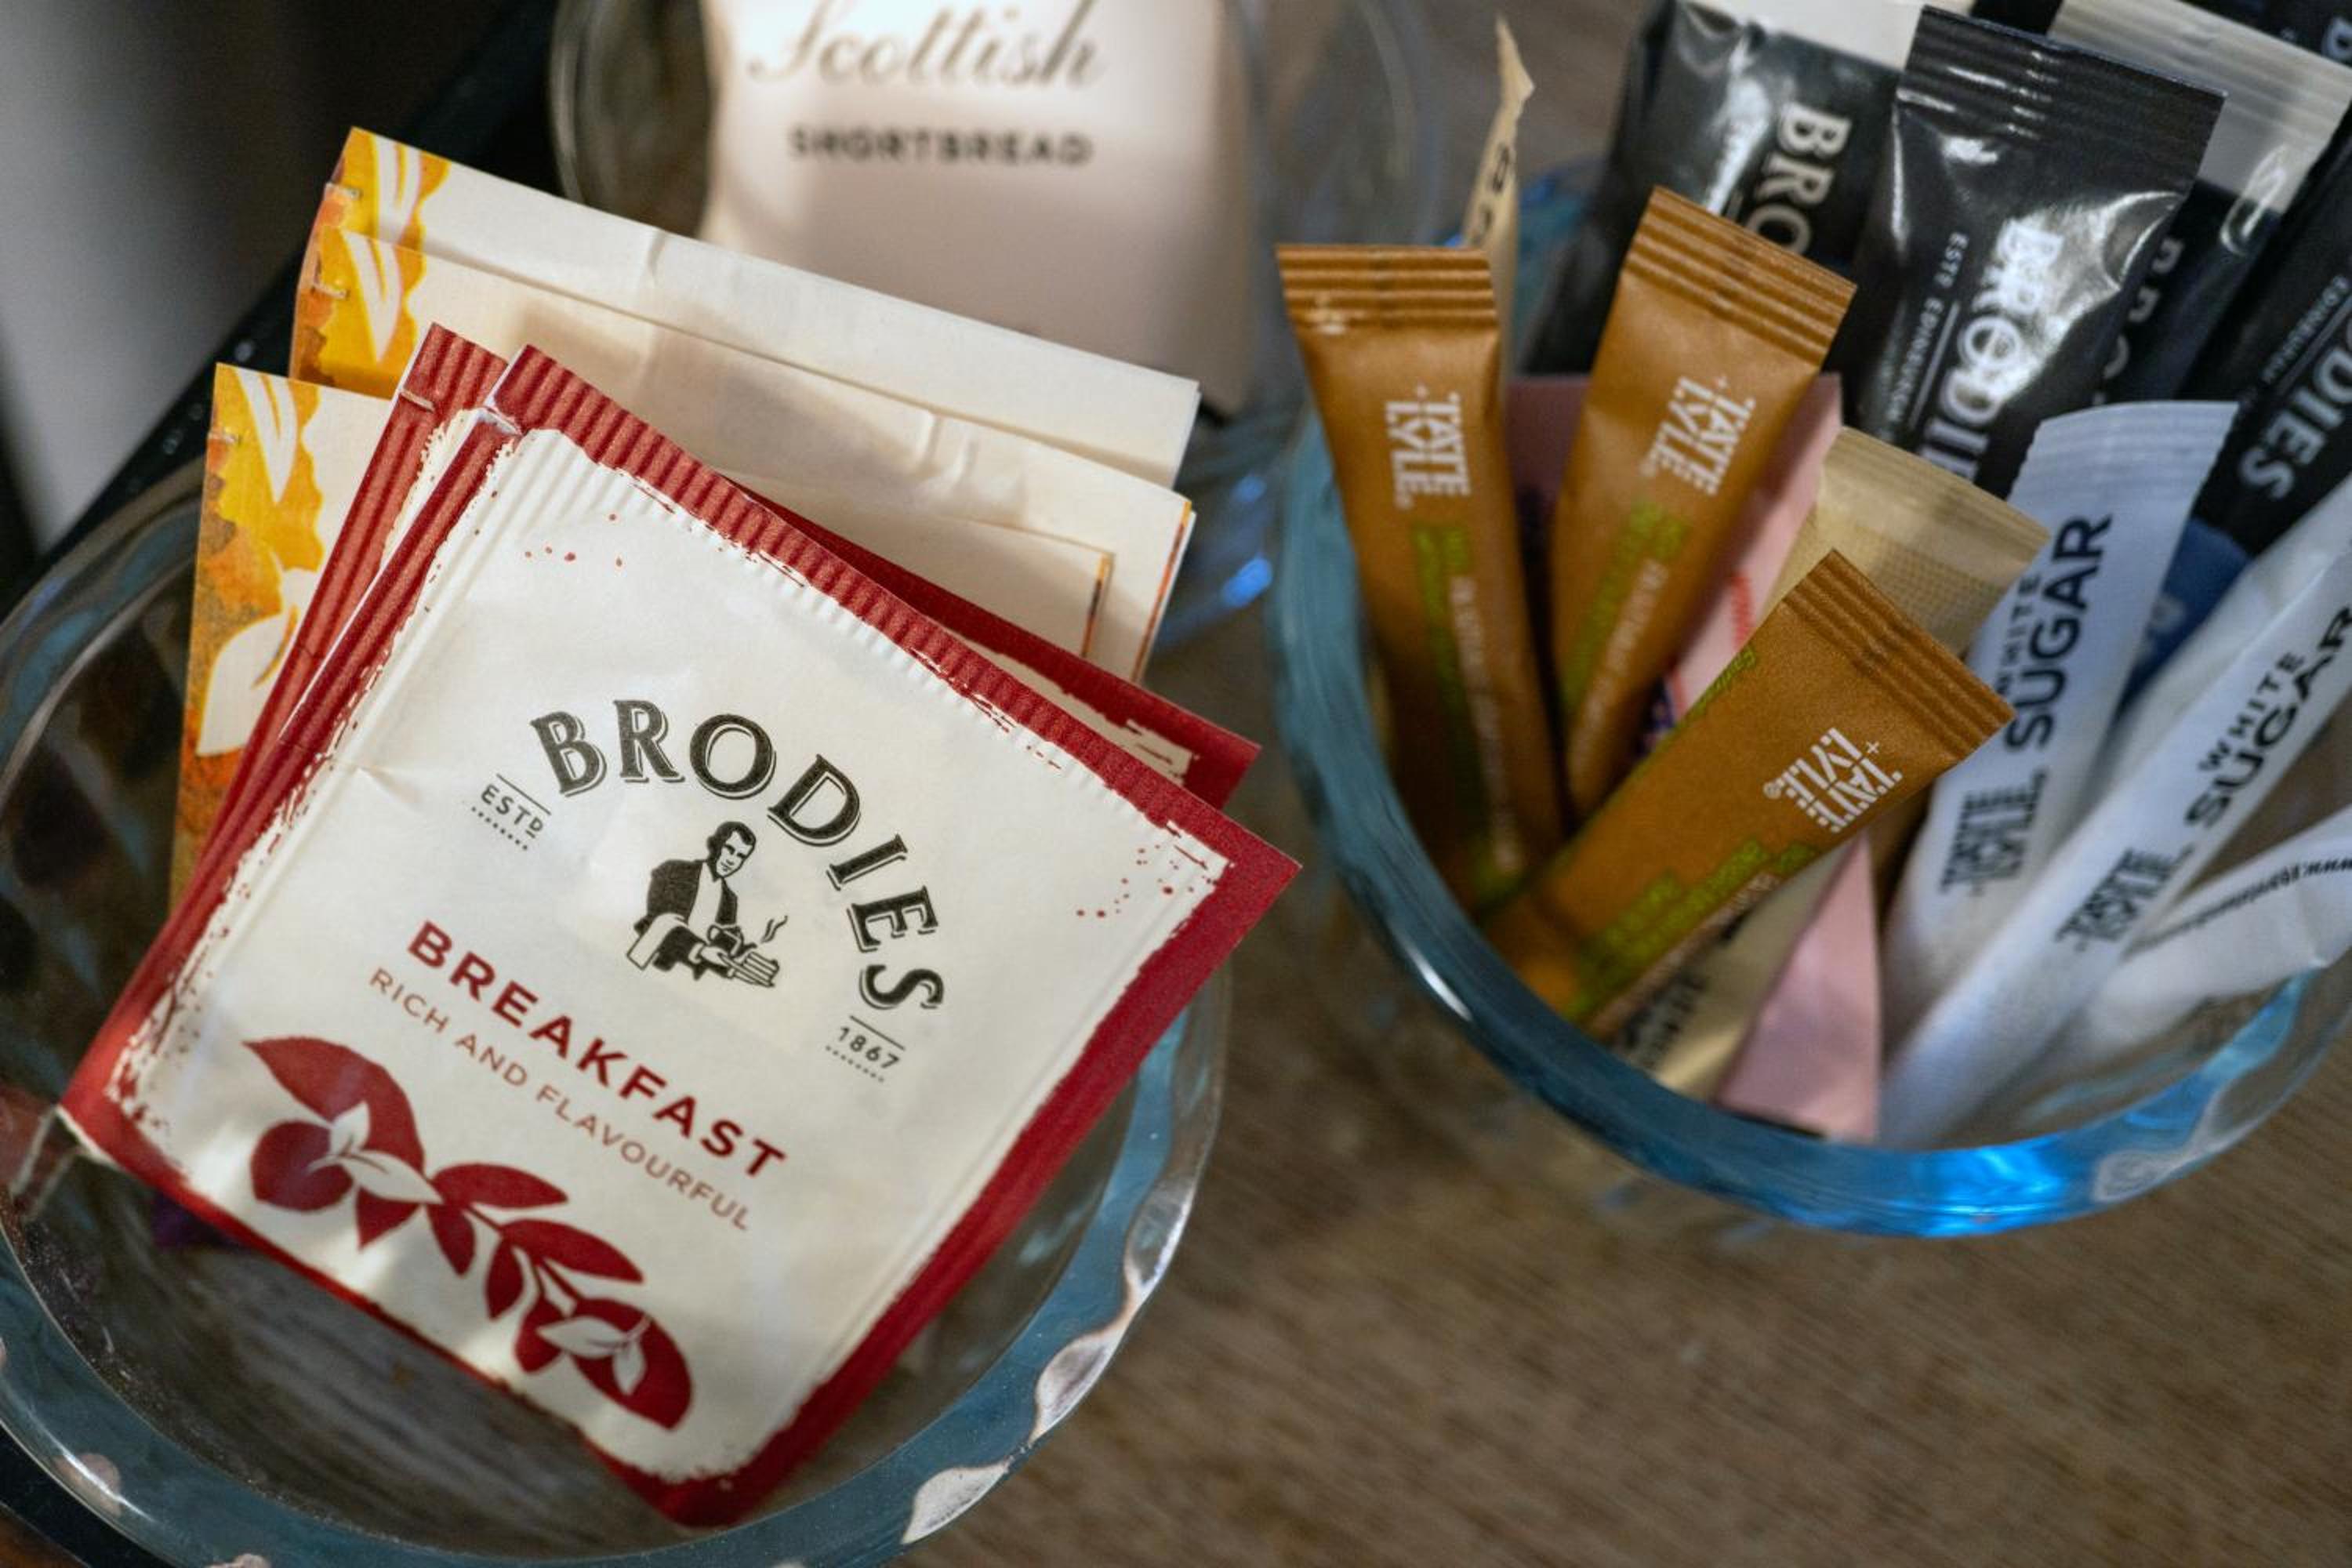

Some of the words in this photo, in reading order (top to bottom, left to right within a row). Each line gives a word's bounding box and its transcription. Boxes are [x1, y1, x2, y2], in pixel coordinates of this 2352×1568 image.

[746, 0, 1105, 86] Scottish
[790, 124, 1093, 165] SHORTBREAD
[1385, 400, 1432, 505] LYLE
[1424, 390, 1472, 496] TATE
[1650, 376, 1715, 474] LYLE
[1684, 396, 1756, 497] TATE
[2004, 514, 2113, 750] SUGAR
[2185, 608, 2352, 828] SUGAR
[2198, 652, 2305, 771] WHITE
[1773, 728, 1863, 811] LYLE
[1805, 757, 1904, 833] TATE
[530, 699, 945, 1011] BRODIES
[369, 967, 450, 1034] RICH
[455, 1033, 528, 1087] AND
[535, 1087, 750, 1232] FLAVOURFUL
[405, 920, 787, 1178] BREAKFAST
[838, 1026, 900, 1068] 1867
